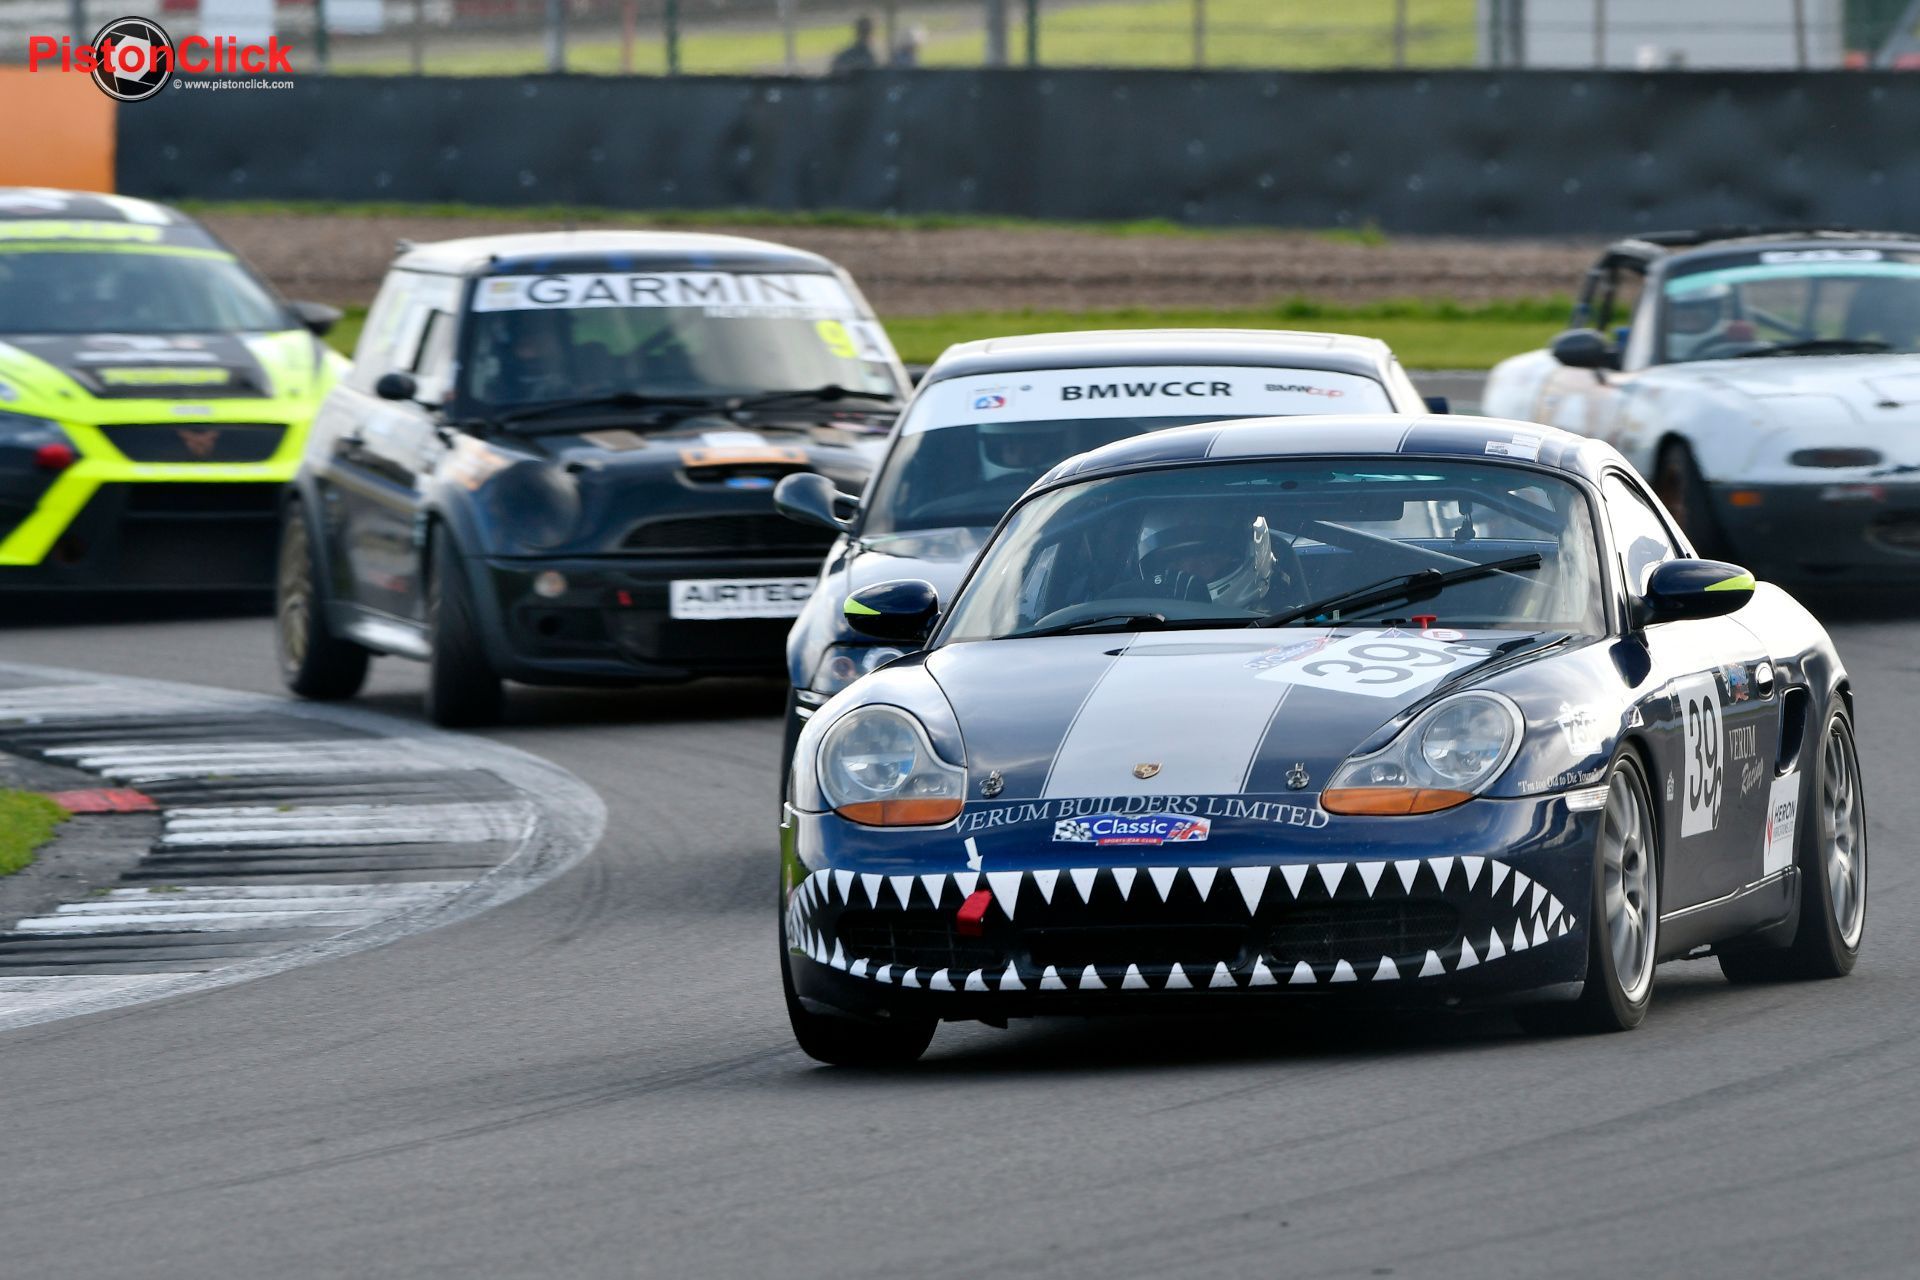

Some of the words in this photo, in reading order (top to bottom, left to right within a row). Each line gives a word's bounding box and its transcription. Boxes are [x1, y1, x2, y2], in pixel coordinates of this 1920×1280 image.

[527, 275, 803, 305] GARMIN
[1061, 381, 1233, 401] BMWCCR
[684, 583, 812, 602] AIRTEC
[1728, 725, 1756, 760] VERUM
[1547, 775, 1559, 787] Old
[1560, 776, 1566, 785] to
[1567, 772, 1578, 784] Die
[1740, 757, 1764, 798] Racing
[955, 801, 1050, 834] VERUM
[1058, 794, 1199, 818] BUILDERS
[1205, 799, 1331, 829] LIMITED
[1774, 800, 1797, 824] HERON
[1093, 818, 1168, 834] Classic
